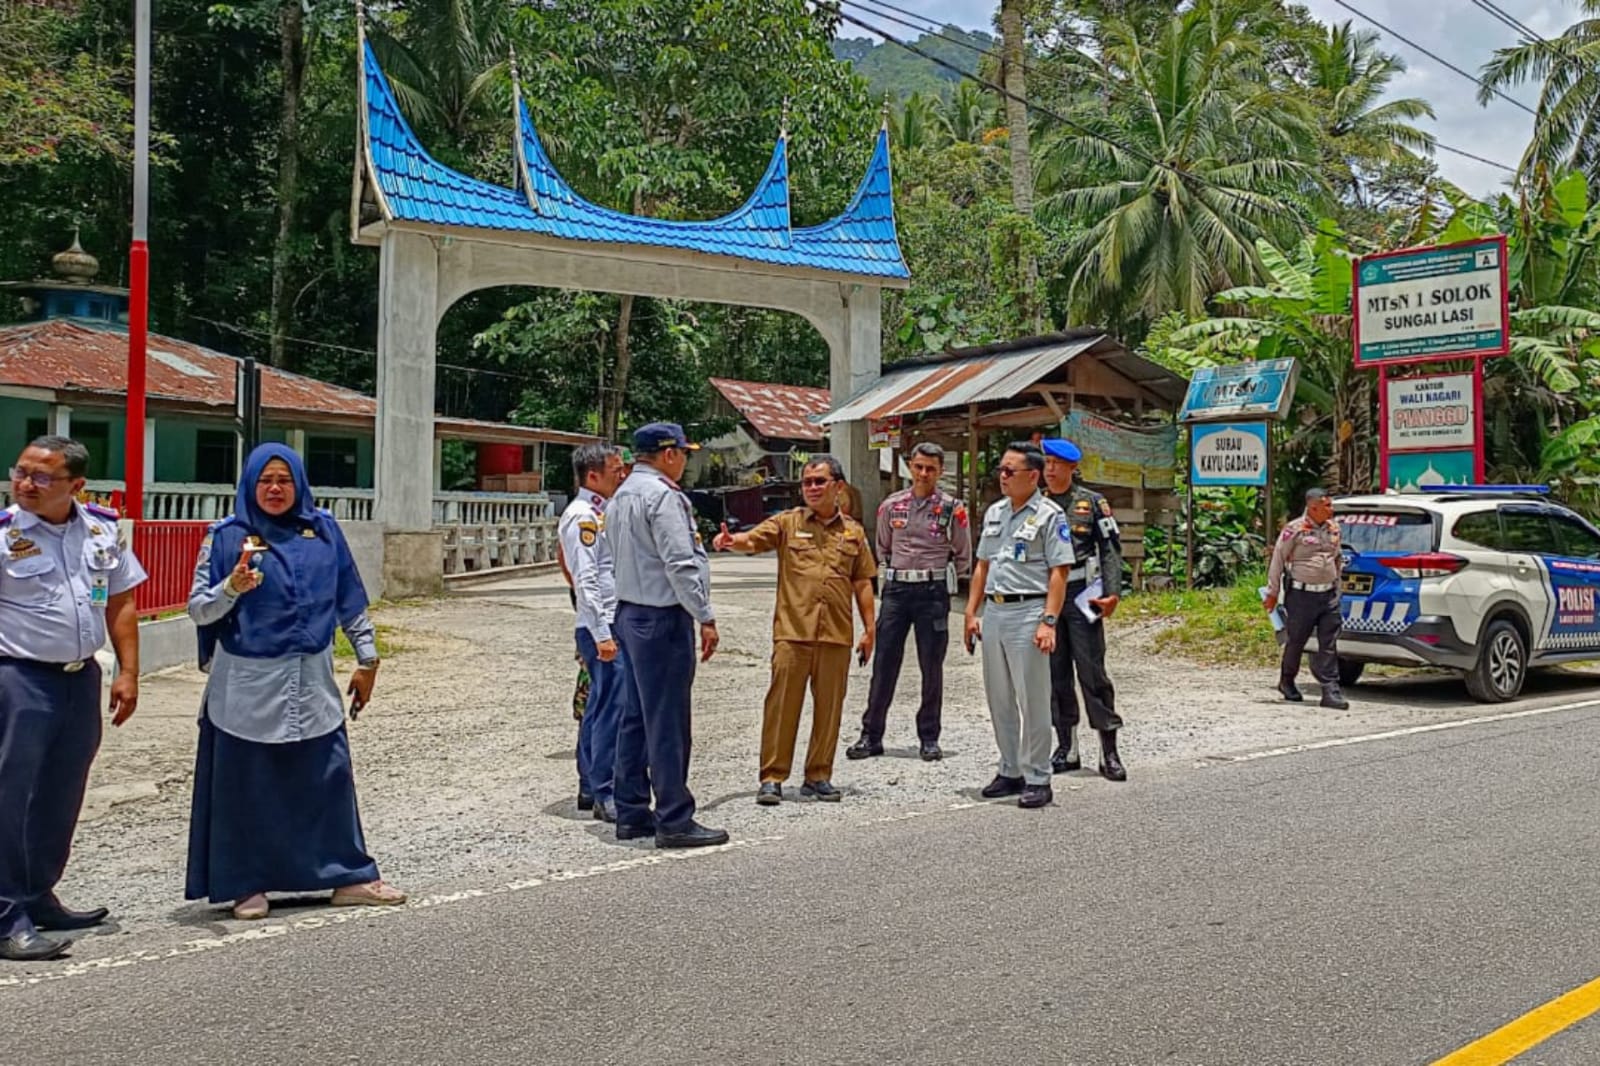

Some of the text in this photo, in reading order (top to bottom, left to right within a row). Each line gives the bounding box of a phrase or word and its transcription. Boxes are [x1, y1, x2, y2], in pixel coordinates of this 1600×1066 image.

[1482, 255, 1491, 266] A
[1368, 283, 1492, 313] MTsN 1 SOLOK
[1384, 307, 1474, 331] SUNGAI LASI
[1400, 390, 1461, 404] WALI NAGARI
[1393, 405, 1469, 430] PIANGGU
[1215, 438, 1242, 451] SURAU
[1201, 455, 1259, 473] KAYU GADANG
[1558, 587, 1595, 611] POLISI
